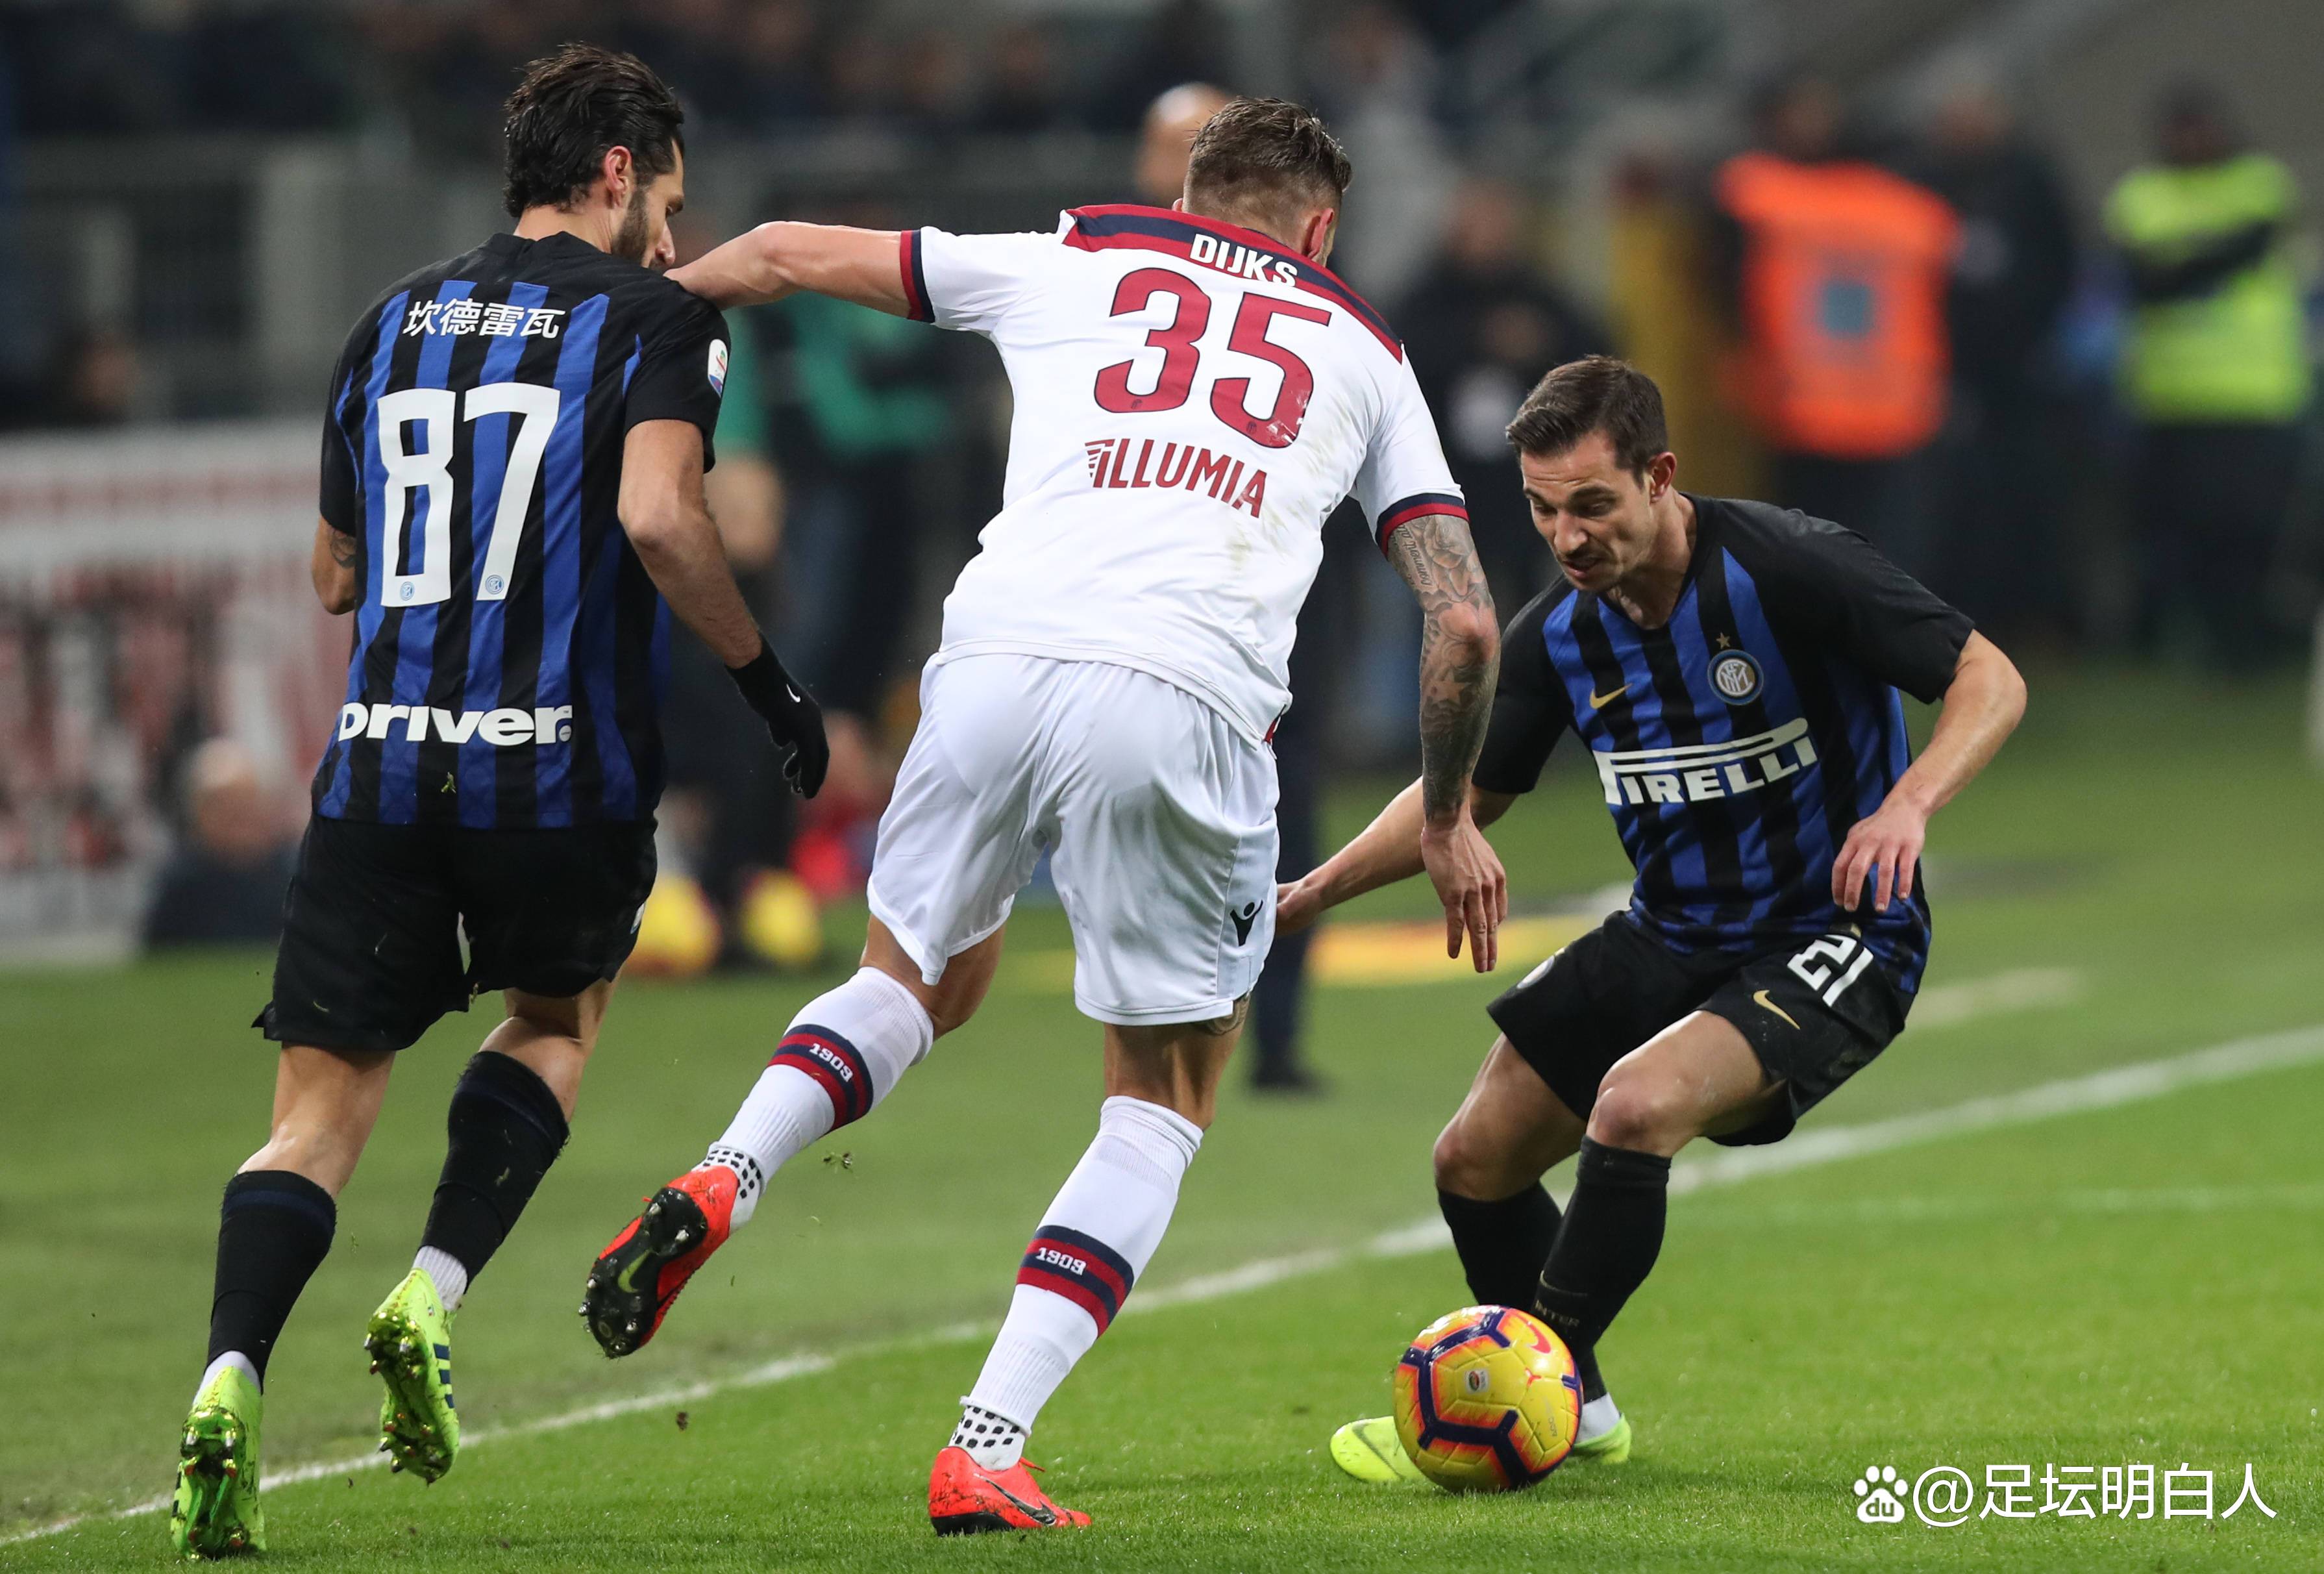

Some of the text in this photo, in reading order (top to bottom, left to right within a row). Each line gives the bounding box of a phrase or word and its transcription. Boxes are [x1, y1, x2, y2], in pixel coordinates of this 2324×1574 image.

[1189, 233, 1298, 287] DIJKS
[402, 297, 566, 338] 坎德雷瓦
[1093, 267, 1332, 449] 35
[377, 382, 560, 607] 87
[1592, 717, 1818, 805] PIRELLI
[1786, 934, 1874, 1008] 21
[809, 1042, 854, 1082] 1909
[1036, 1247, 1087, 1275] 1909
